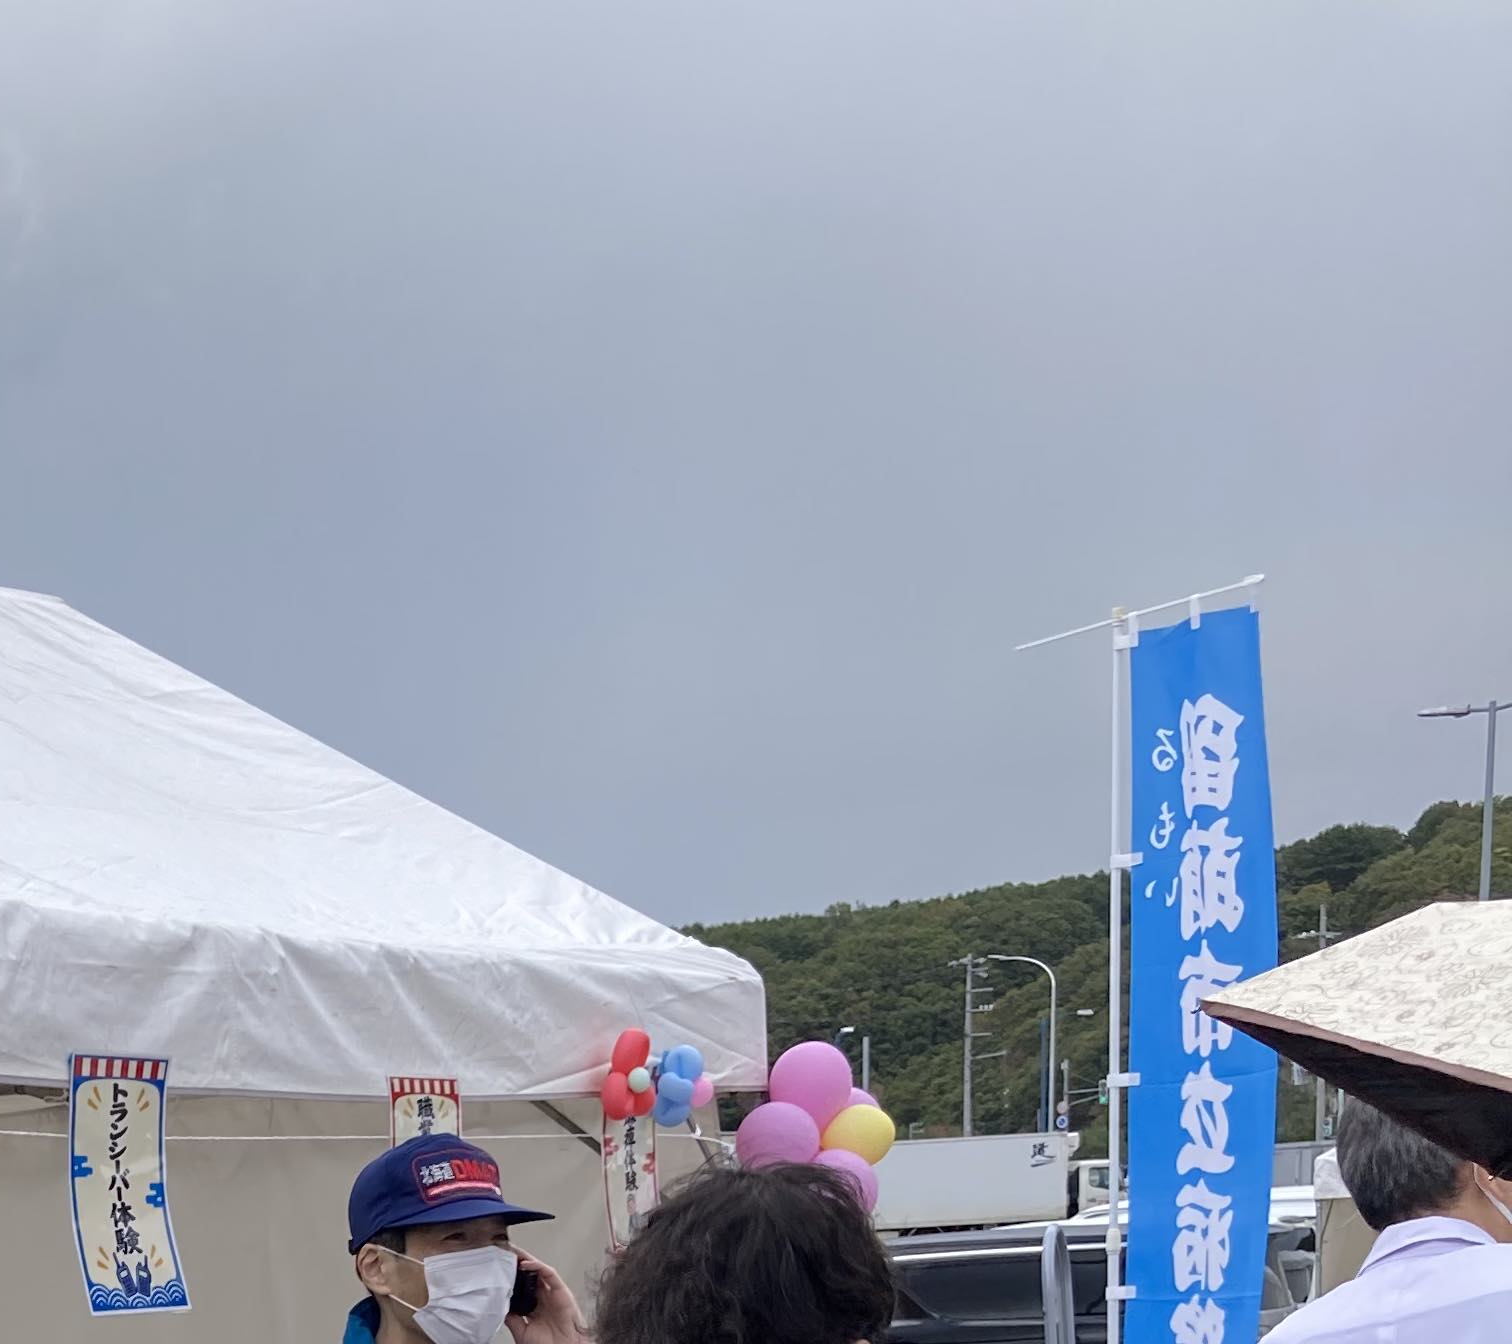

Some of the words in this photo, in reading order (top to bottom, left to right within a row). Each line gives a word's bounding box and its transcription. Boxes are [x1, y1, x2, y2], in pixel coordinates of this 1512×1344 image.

[108, 1081, 144, 1256] トランシーバー体験
